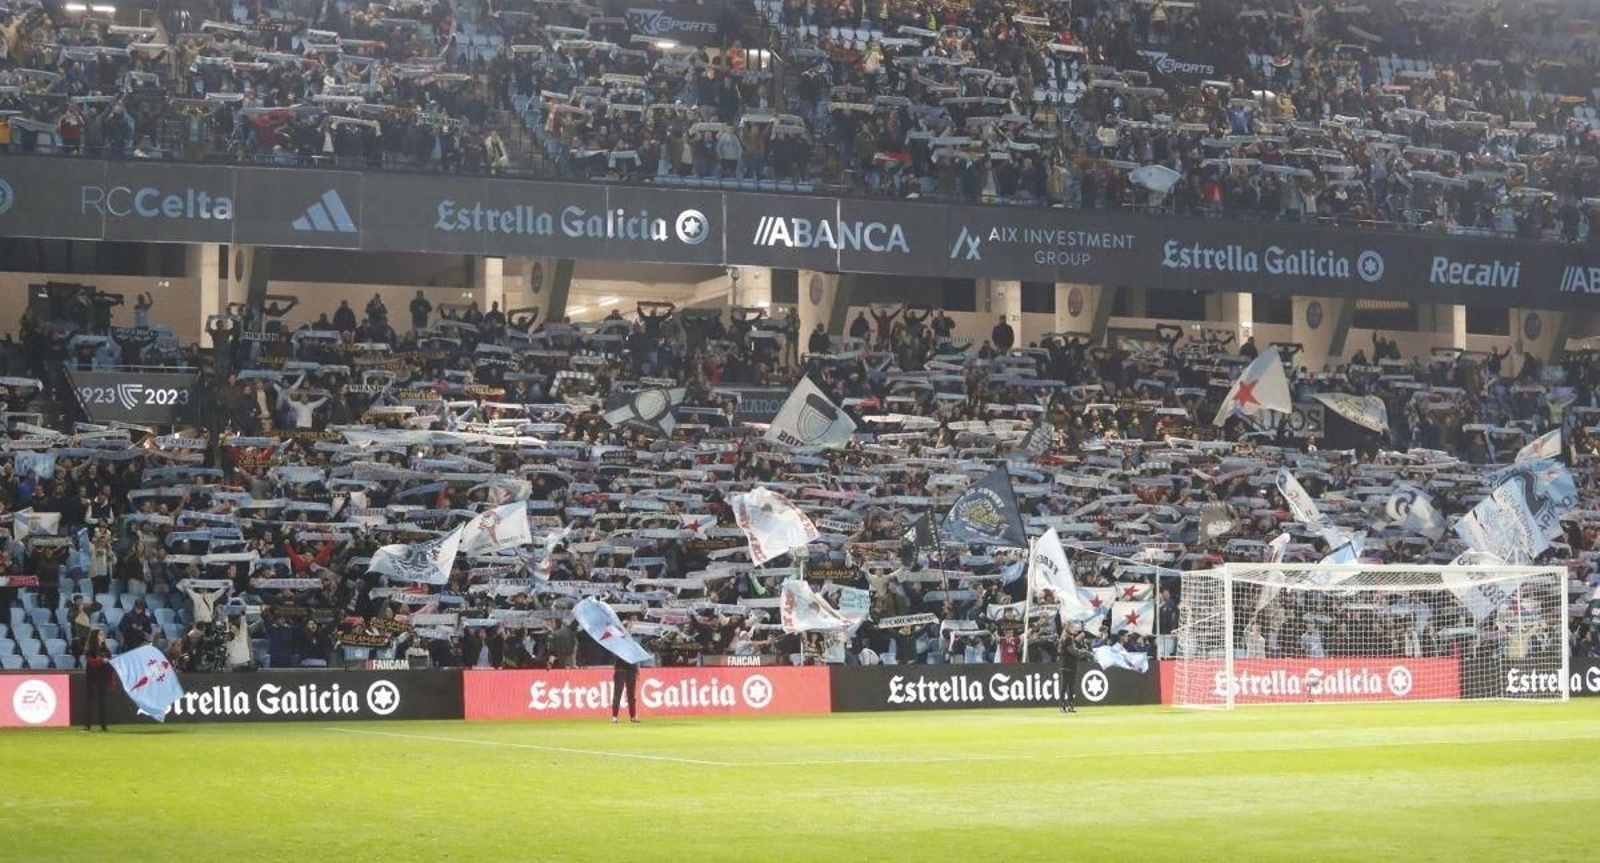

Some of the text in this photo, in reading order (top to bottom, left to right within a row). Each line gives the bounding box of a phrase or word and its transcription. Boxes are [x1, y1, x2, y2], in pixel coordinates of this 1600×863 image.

[434, 199, 669, 242] Estrella Galicia
[989, 227, 1135, 249] AIX INVESTMENT
[1034, 250, 1091, 266] GROUP
[1162, 239, 1350, 278] Estrella Galicia
[1429, 256, 1521, 288] Recalvi
[144, 388, 190, 405] 2023
[727, 655, 761, 666] FANCAM
[641, 678, 736, 708] Galicia
[887, 673, 1075, 703] Estrella Galici
[1506, 668, 1582, 692] Estrela
[22, 690, 48, 703] EA
[256, 683, 359, 715] Galicia
